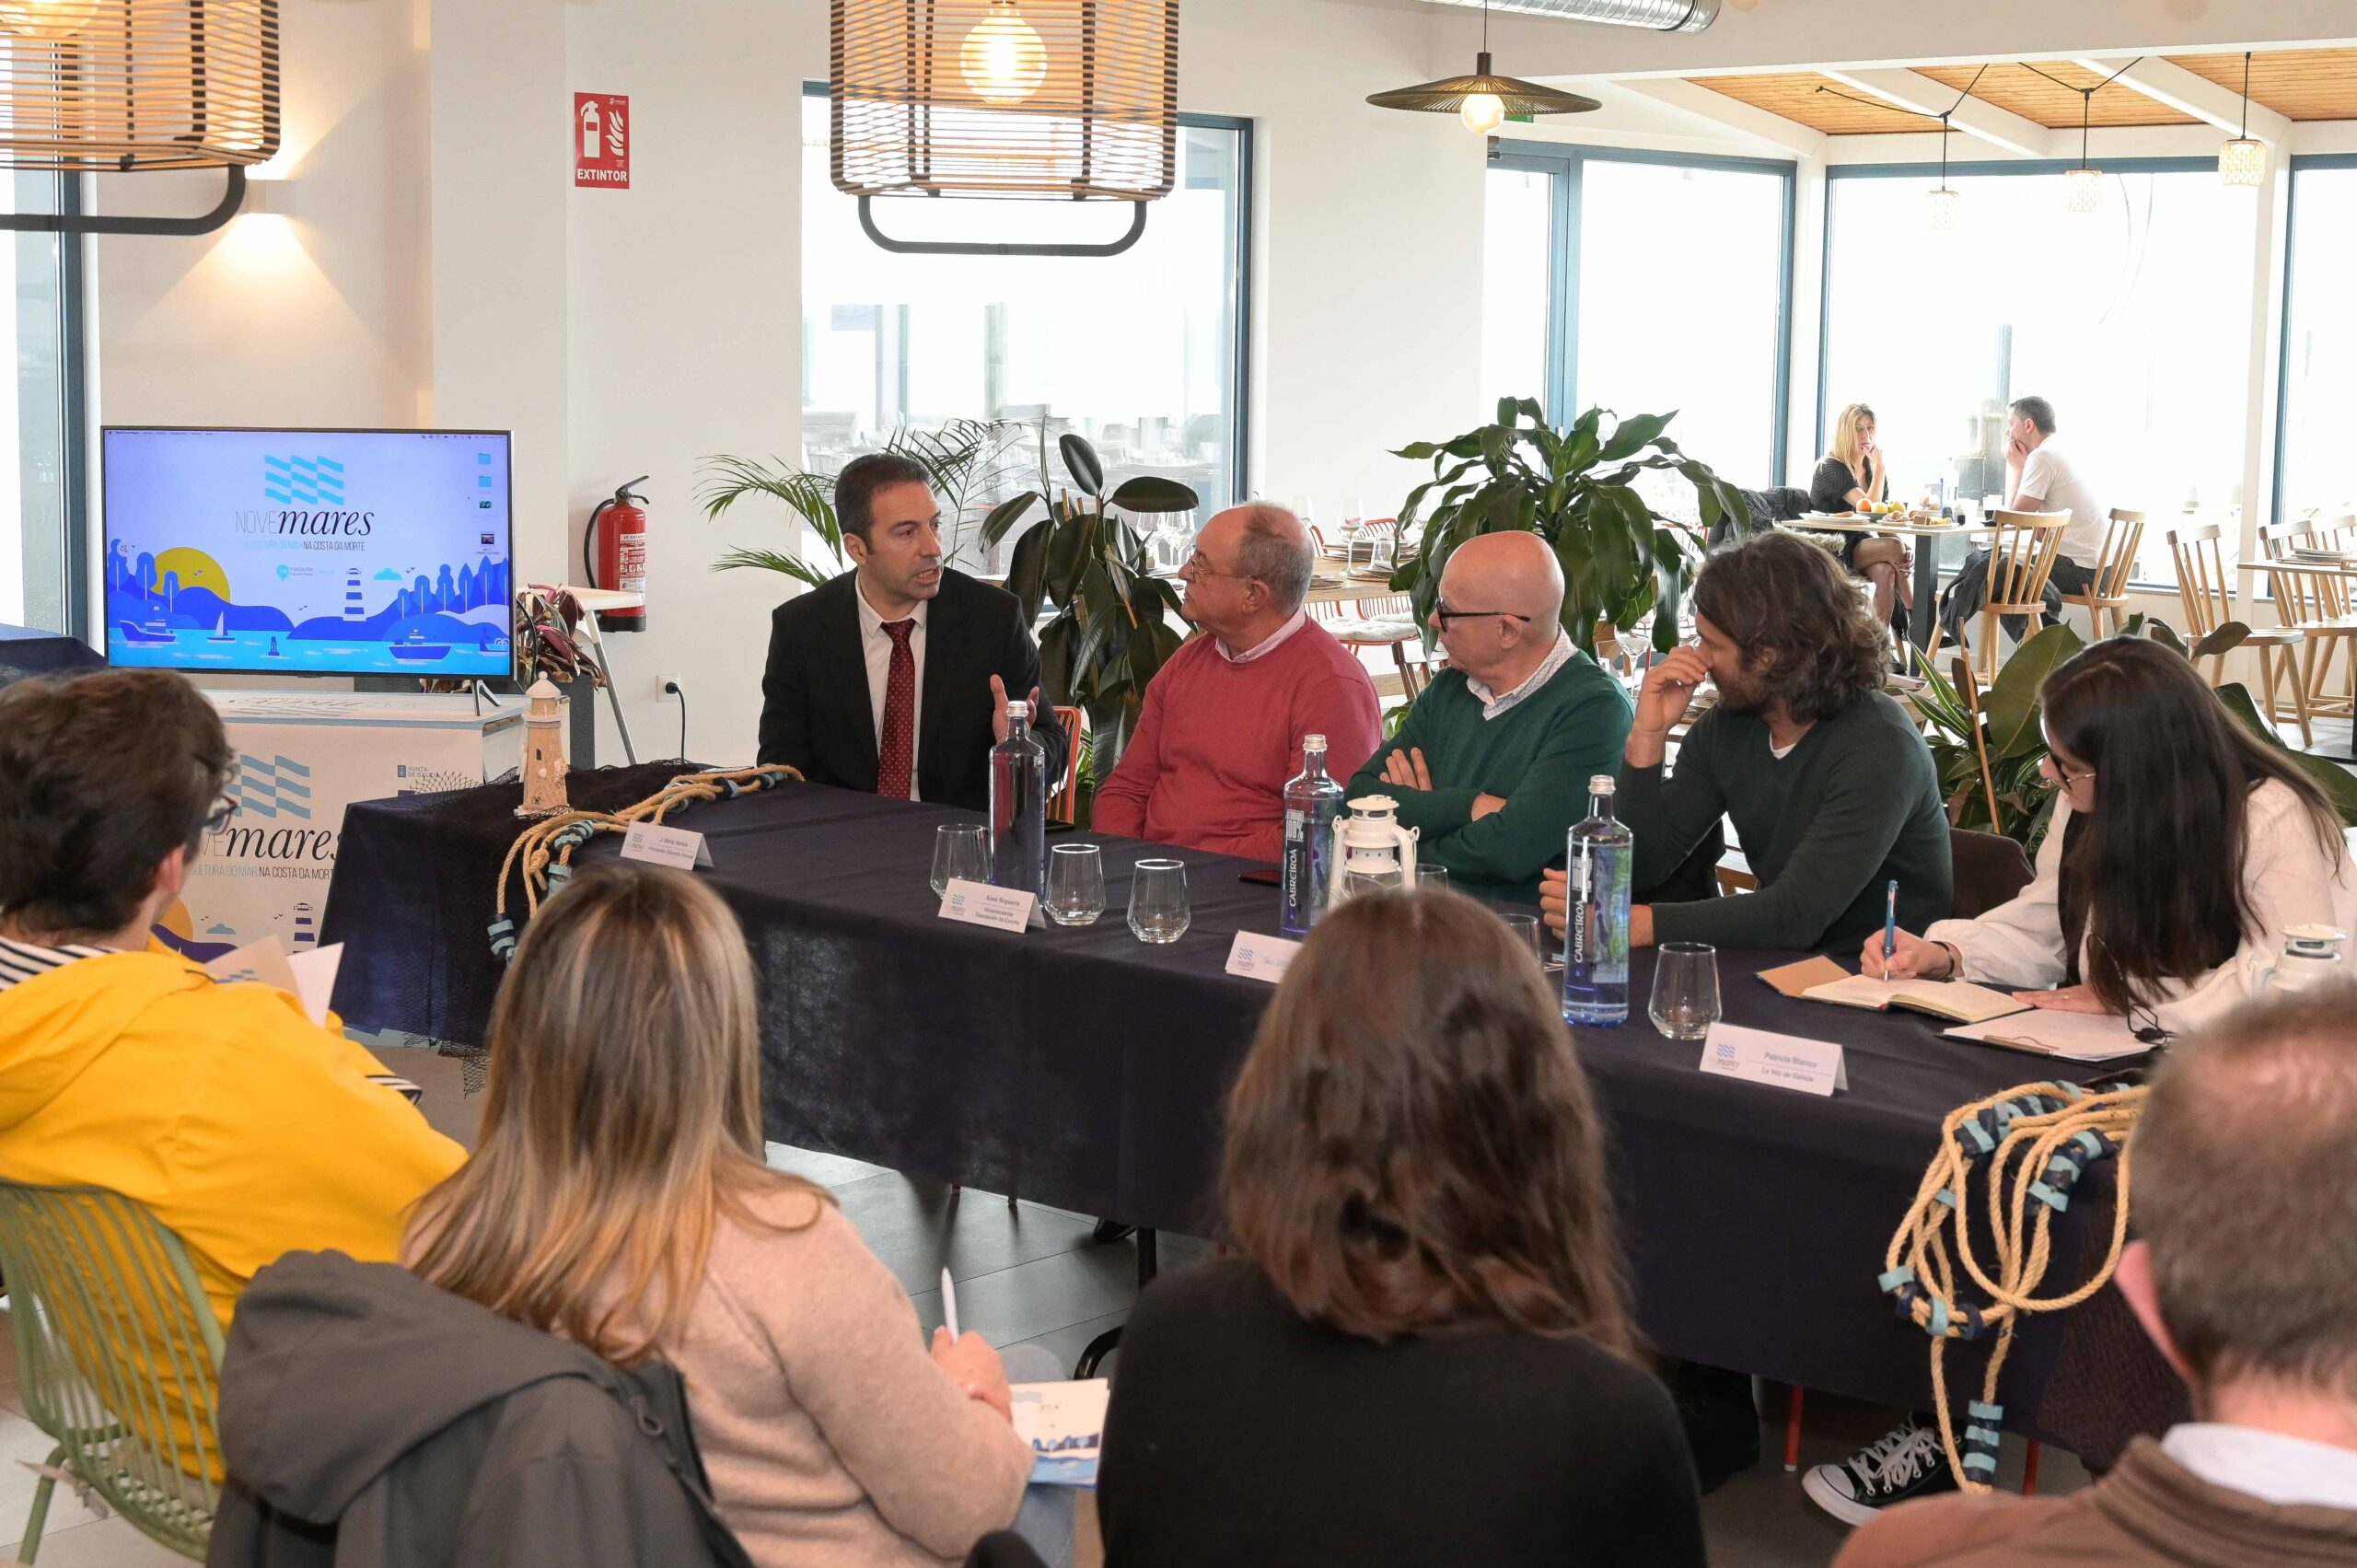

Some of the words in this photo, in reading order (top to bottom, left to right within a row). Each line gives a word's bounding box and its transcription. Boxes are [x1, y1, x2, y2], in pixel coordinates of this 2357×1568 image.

[577, 168, 627, 181] EXTINTOR
[303, 540, 312, 550] NA
[314, 540, 332, 551] COSTA
[333, 541, 343, 551] DA
[344, 541, 366, 552] MORTE
[259, 866, 271, 877] NA
[273, 867, 297, 878] COSTA
[299, 868, 310, 879] DA
[311, 868, 334, 880] MORT
